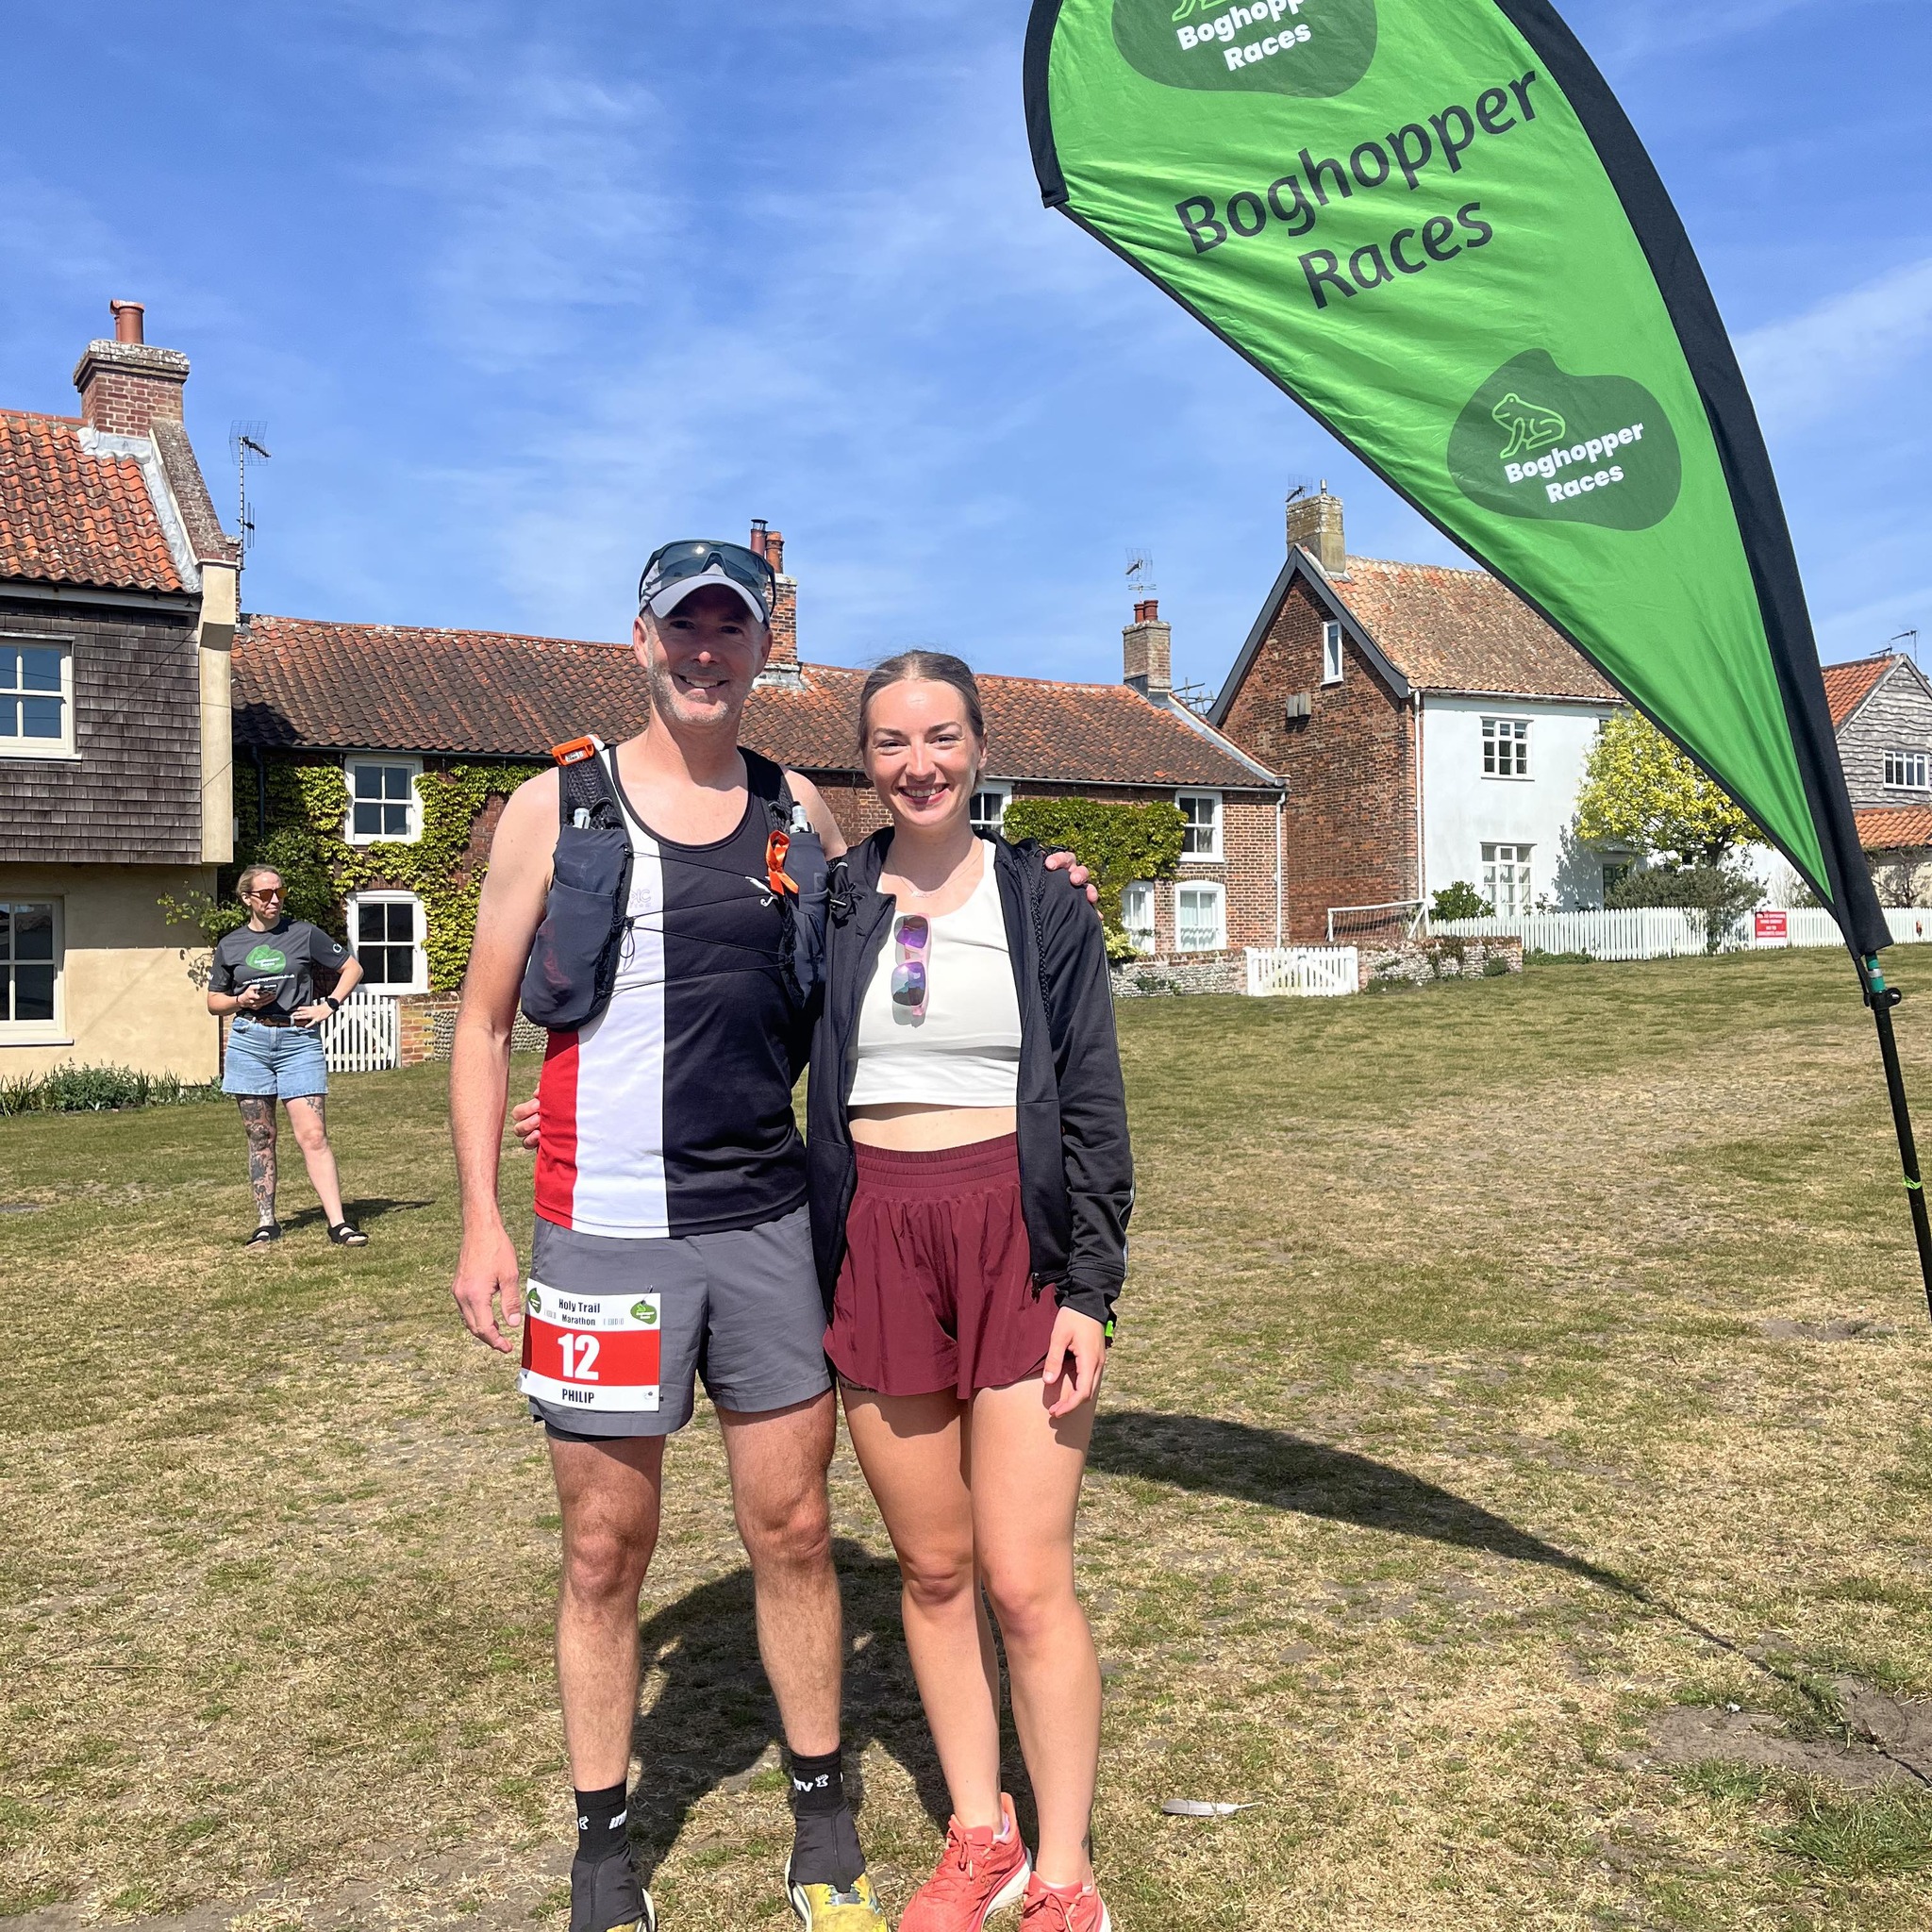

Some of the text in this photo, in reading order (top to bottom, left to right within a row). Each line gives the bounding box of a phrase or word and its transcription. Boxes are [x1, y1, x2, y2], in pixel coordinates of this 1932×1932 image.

[1223, 24, 1311, 72] Races
[1175, 71, 1537, 254] Boghopper
[1299, 202, 1493, 309] Races
[1505, 423, 1644, 484] Boghopper
[1545, 465, 1624, 504] Races
[558, 1298, 601, 1313] Holy Trail
[561, 1314, 596, 1326] Marathon
[557, 1333, 601, 1381] 12
[561, 1389, 595, 1404] PHILIP
